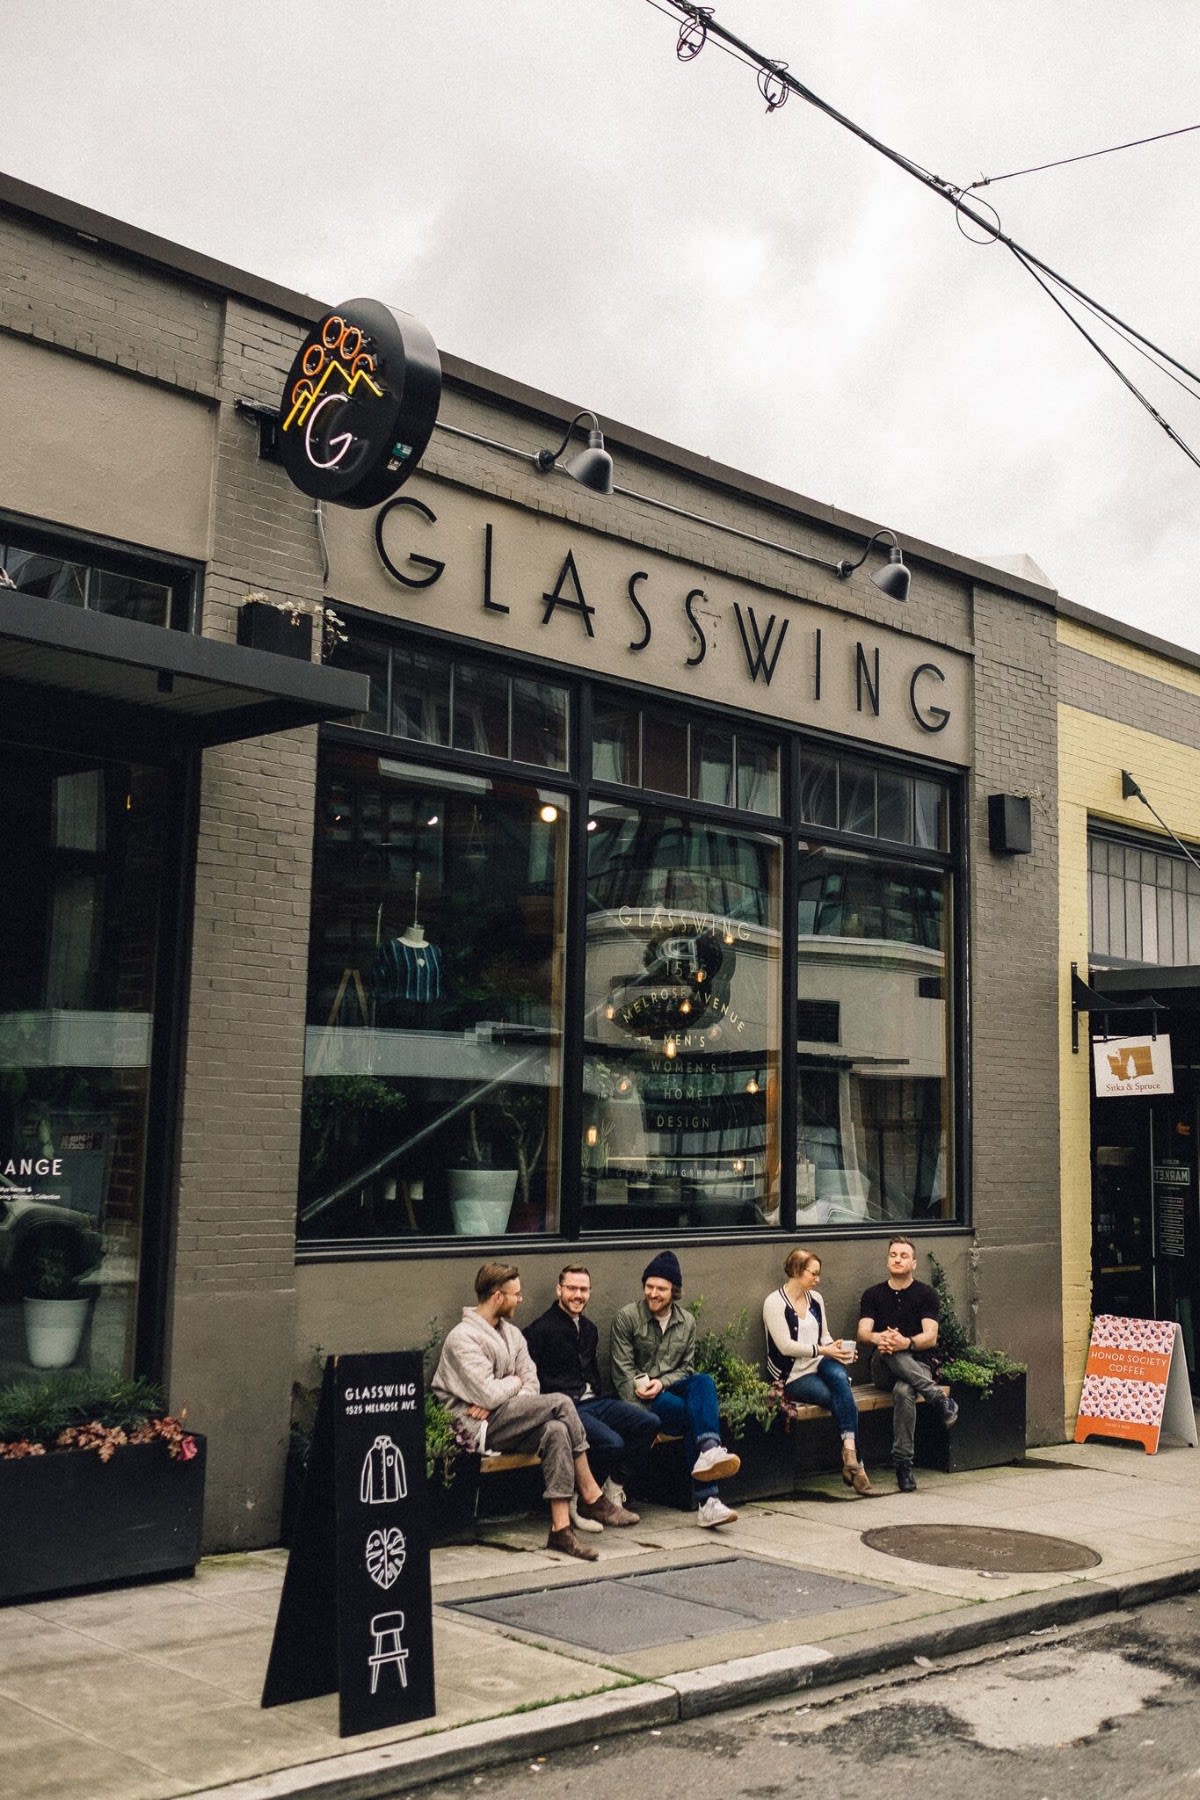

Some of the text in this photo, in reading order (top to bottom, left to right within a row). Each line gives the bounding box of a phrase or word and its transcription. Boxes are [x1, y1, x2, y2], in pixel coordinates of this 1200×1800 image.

[305, 393, 353, 469] G
[374, 496, 951, 733] GLASSWING
[618, 905, 751, 941] GLASSWING
[623, 987, 745, 1033] MELROSE AVENUE
[664, 1034, 706, 1048] MEN'S
[651, 1060, 717, 1075] WOMEN'S
[664, 1088, 703, 1101] HOME
[1105, 1082, 1161, 1092] Sitka & Spruce
[656, 1114, 710, 1129] DESIGN
[0, 1158, 64, 1176] ANGE
[1090, 1351, 1168, 1367] HONOR SOCIETY
[1108, 1363, 1146, 1376] COFFEE
[344, 1382, 416, 1401] GLASSWING
[364, 1401, 399, 1414] MELROSE
